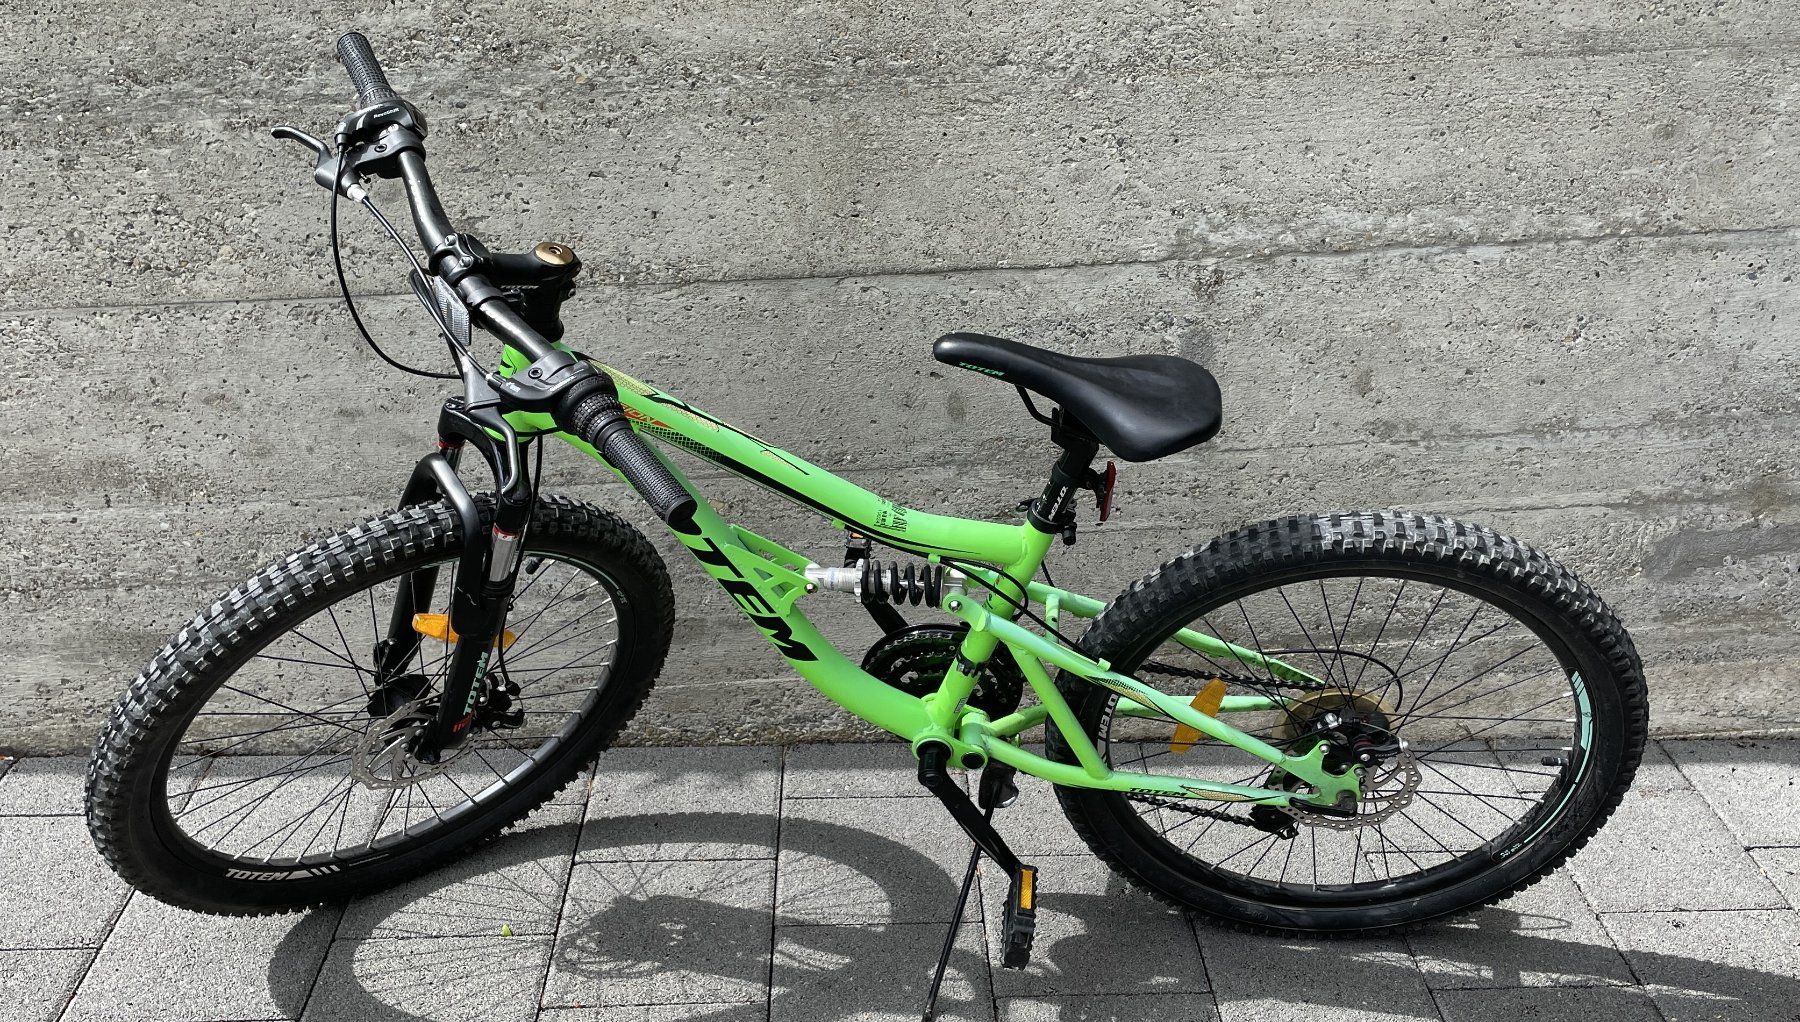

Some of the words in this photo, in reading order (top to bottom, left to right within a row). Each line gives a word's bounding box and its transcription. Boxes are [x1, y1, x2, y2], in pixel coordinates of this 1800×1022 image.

[959, 361, 1005, 376] TOTEM
[666, 516, 820, 662] TEM
[463, 651, 489, 716] TOTEM
[1098, 693, 1119, 739] OTEM
[1129, 787, 1188, 797] TOTEM
[225, 868, 290, 881] TOTEM
